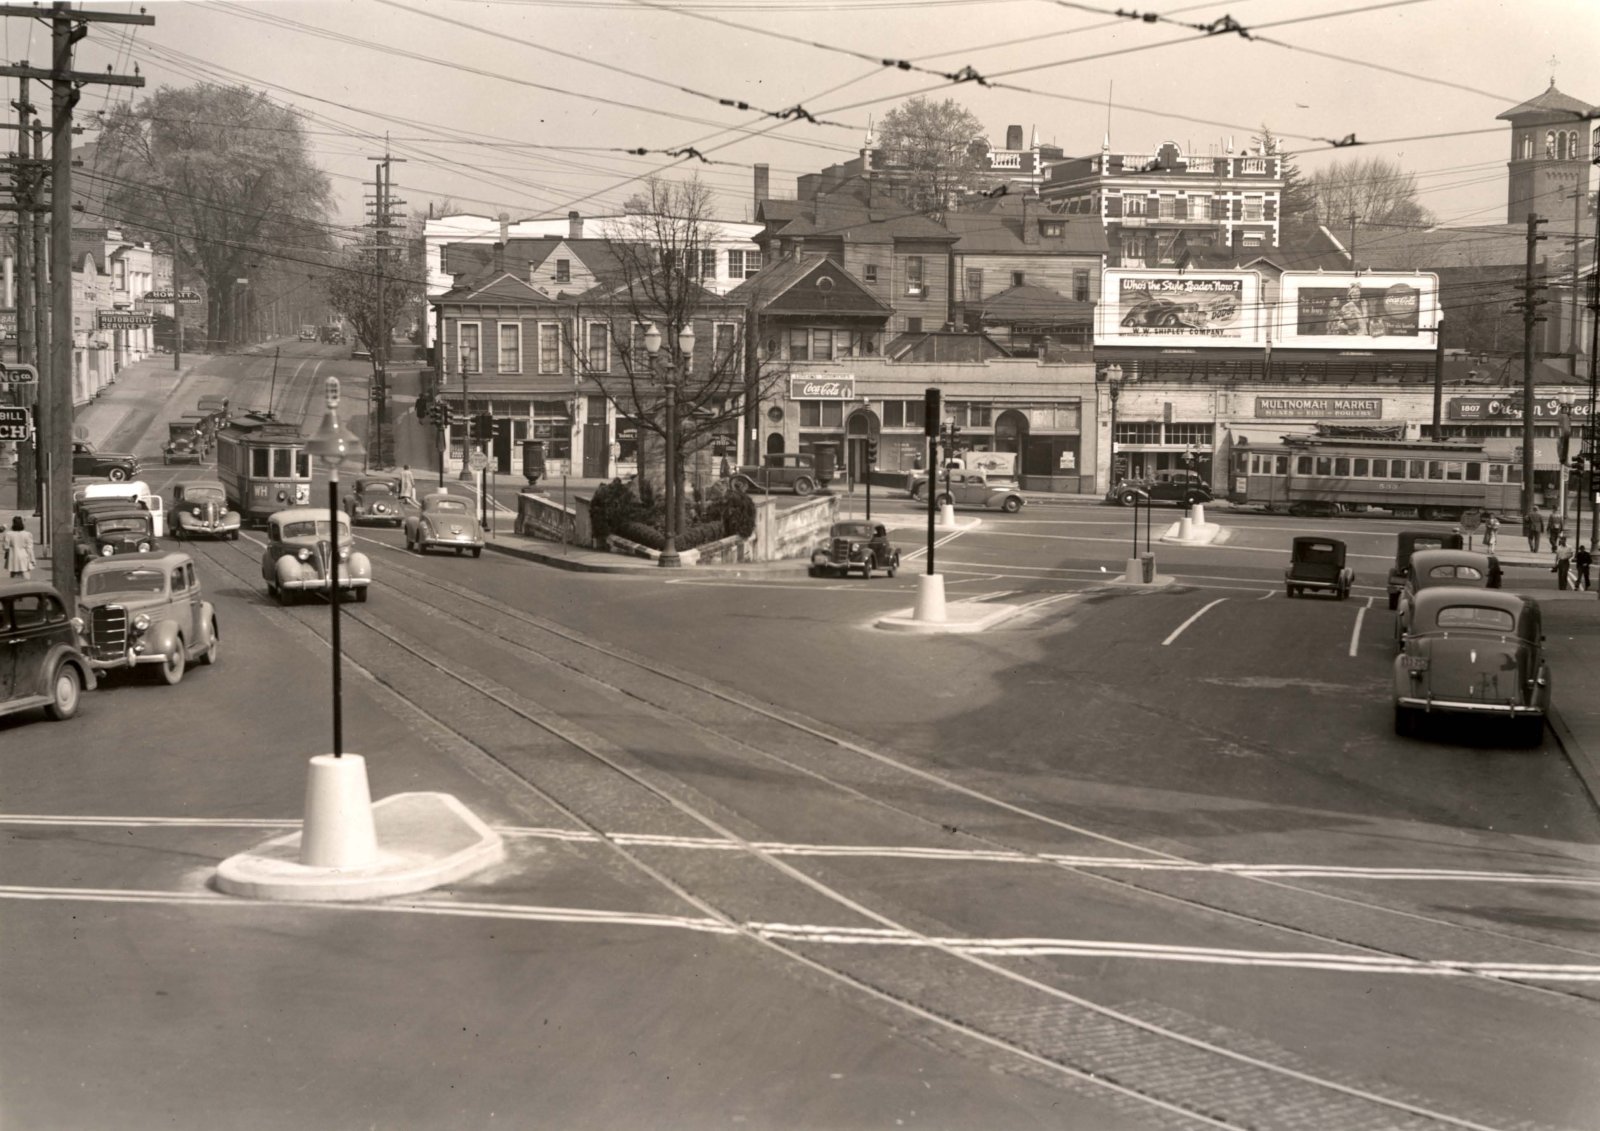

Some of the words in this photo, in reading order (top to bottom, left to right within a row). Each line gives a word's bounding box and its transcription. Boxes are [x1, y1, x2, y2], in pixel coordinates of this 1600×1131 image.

[1123, 279, 1146, 290] Who's
[1148, 279, 1160, 290] the
[1162, 280, 1184, 293] Style
[1185, 281, 1213, 293] Leader
[803, 383, 840, 395] Coca-Cola
[1261, 400, 1327, 410] MULTNOMAH
[1335, 401, 1379, 410] MARKET
[1488, 400, 1543, 418] Oregn
[254, 486, 267, 497] WH
